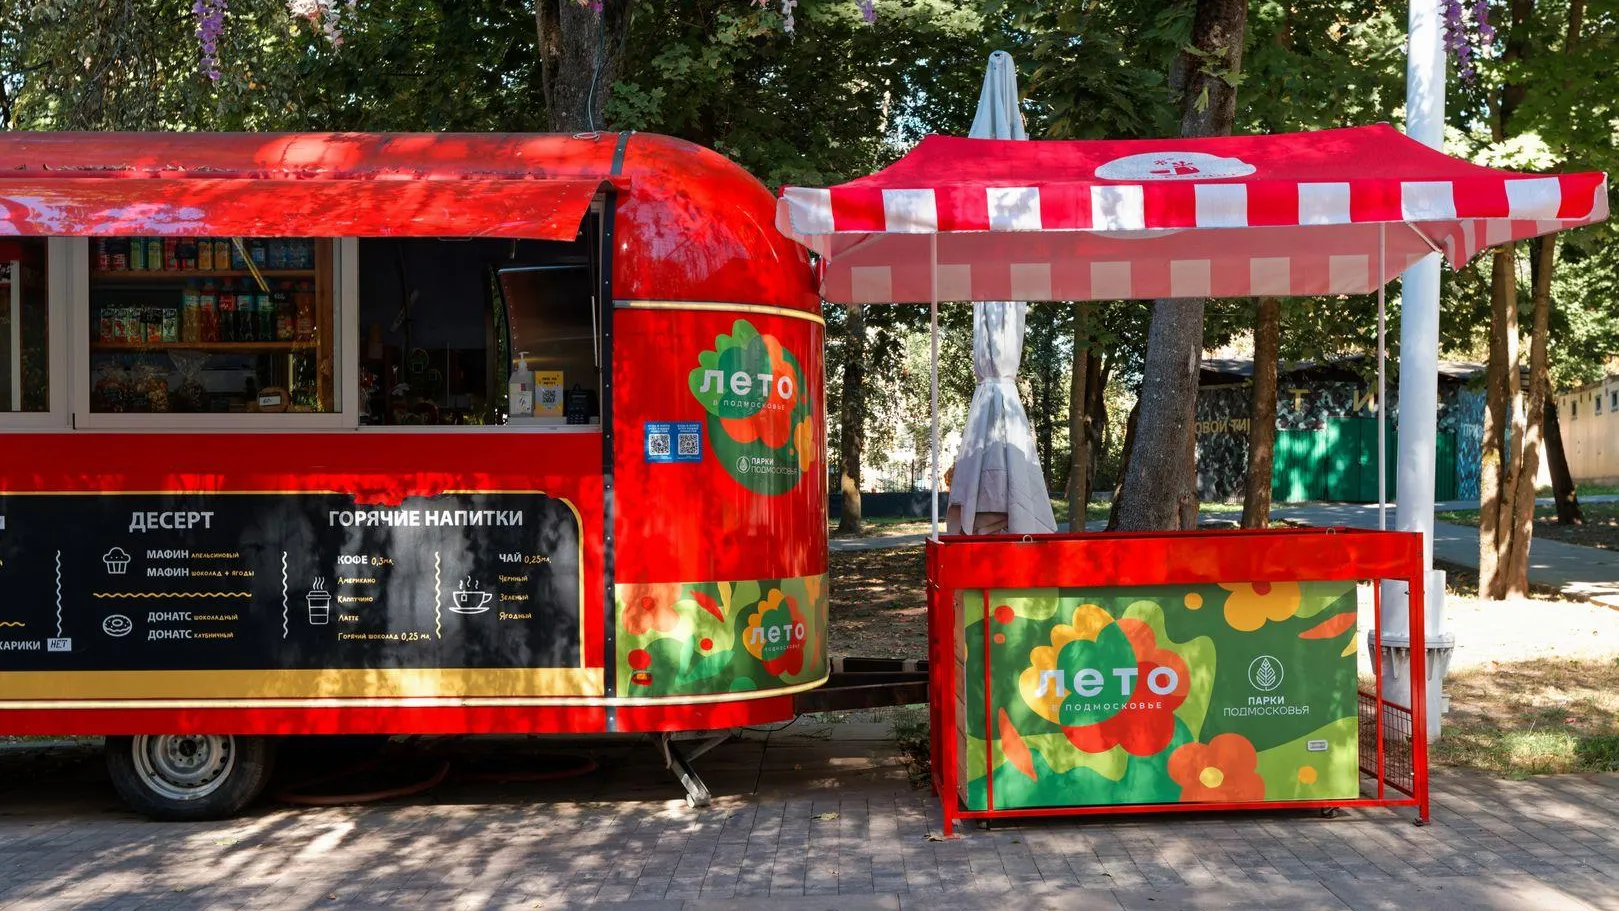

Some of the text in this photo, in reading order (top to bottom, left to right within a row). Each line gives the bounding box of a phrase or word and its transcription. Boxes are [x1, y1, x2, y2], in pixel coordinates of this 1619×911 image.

[723, 400, 785, 411] ПОДМОСКОВЬЕ
[751, 457, 774, 466] ПАРКИ
[751, 465, 798, 475] ПОДМОСКОВЬЯ
[129, 511, 214, 533] ДЕСЕРТ
[329, 510, 523, 527] ГОРЯЧИЕ НАПИТКИ
[146, 549, 189, 559] МАФИН
[499, 552, 522, 563] ЧАЙ
[337, 555, 368, 565] КОФЕ
[147, 567, 189, 577] МАФИН
[147, 611, 192, 623] ДОНАТС
[147, 629, 193, 641] ДОНАТС
[401, 631, 419, 641] 0,25
[0, 640, 41, 651] АРИКИ
[51, 639, 68, 649] НЕТ
[1248, 695, 1285, 706] ПАРКИ
[1065, 701, 1162, 712] ПОДМОСКОВЬЕ
[1223, 705, 1310, 717] ПОДМОСКОВЬЯ
